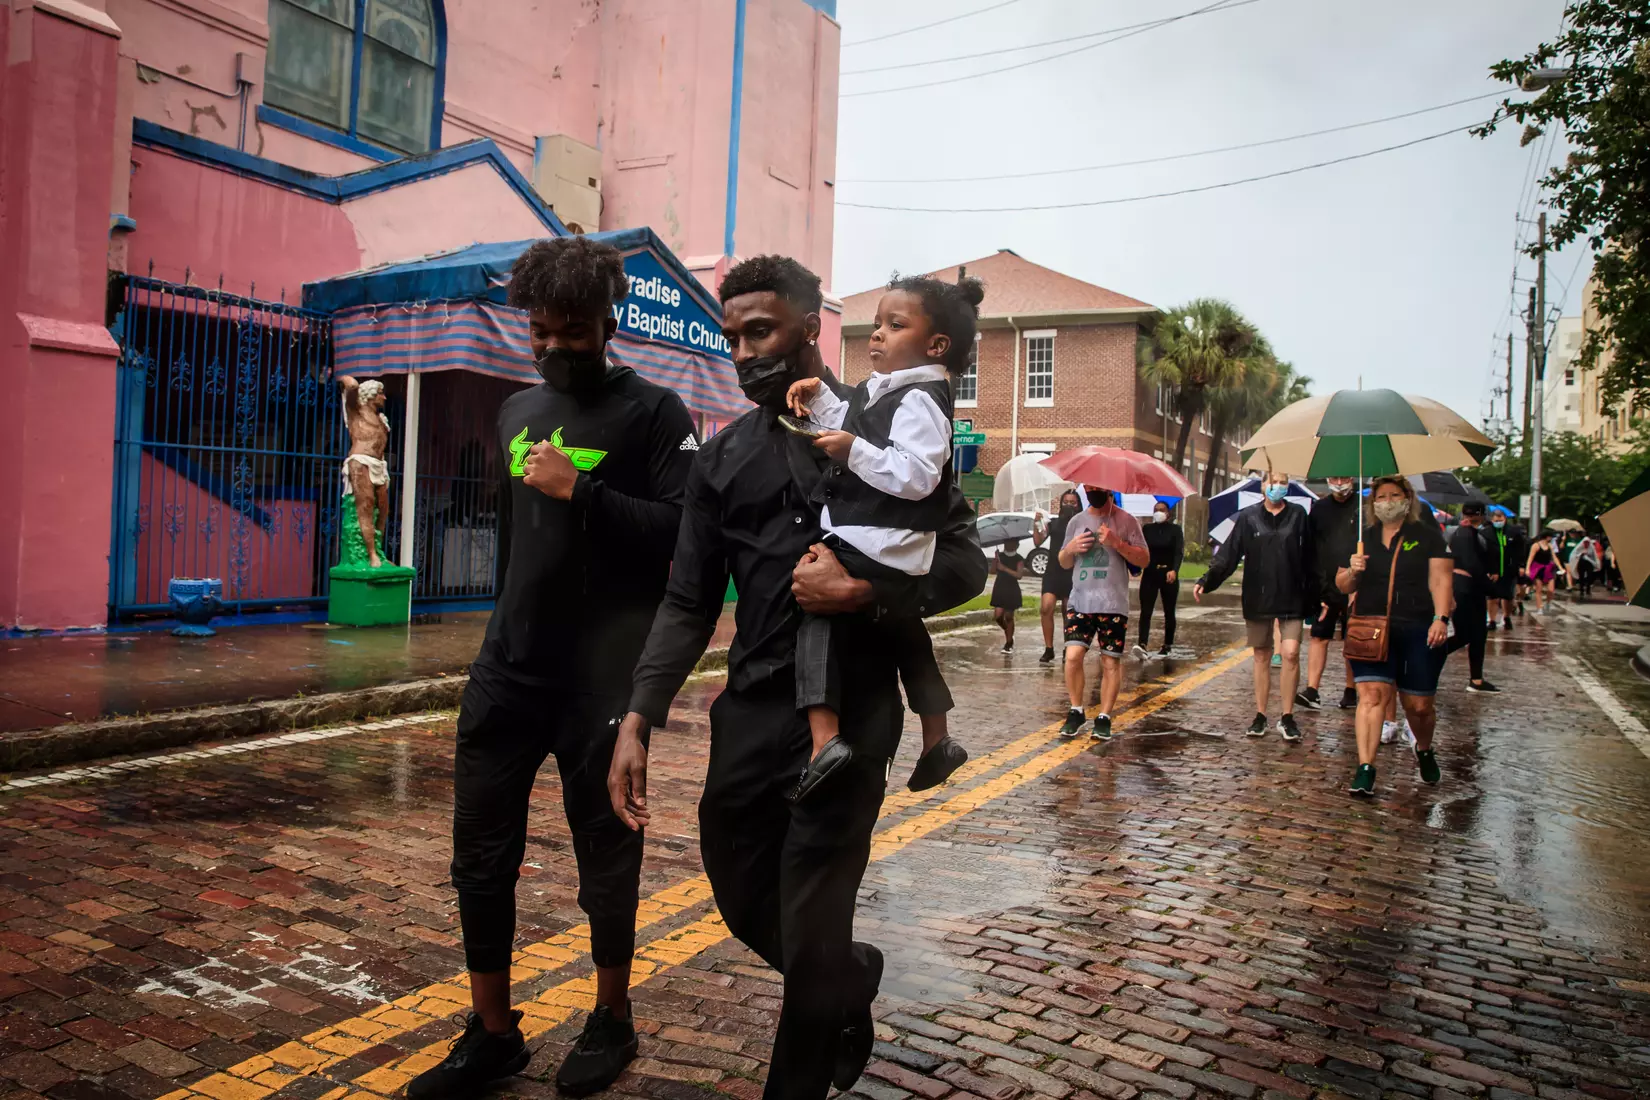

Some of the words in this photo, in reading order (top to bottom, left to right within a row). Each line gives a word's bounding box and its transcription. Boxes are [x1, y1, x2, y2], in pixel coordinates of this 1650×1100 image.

[622, 272, 681, 307] radise
[627, 303, 685, 341] Baptist
[688, 321, 731, 353] Churc
